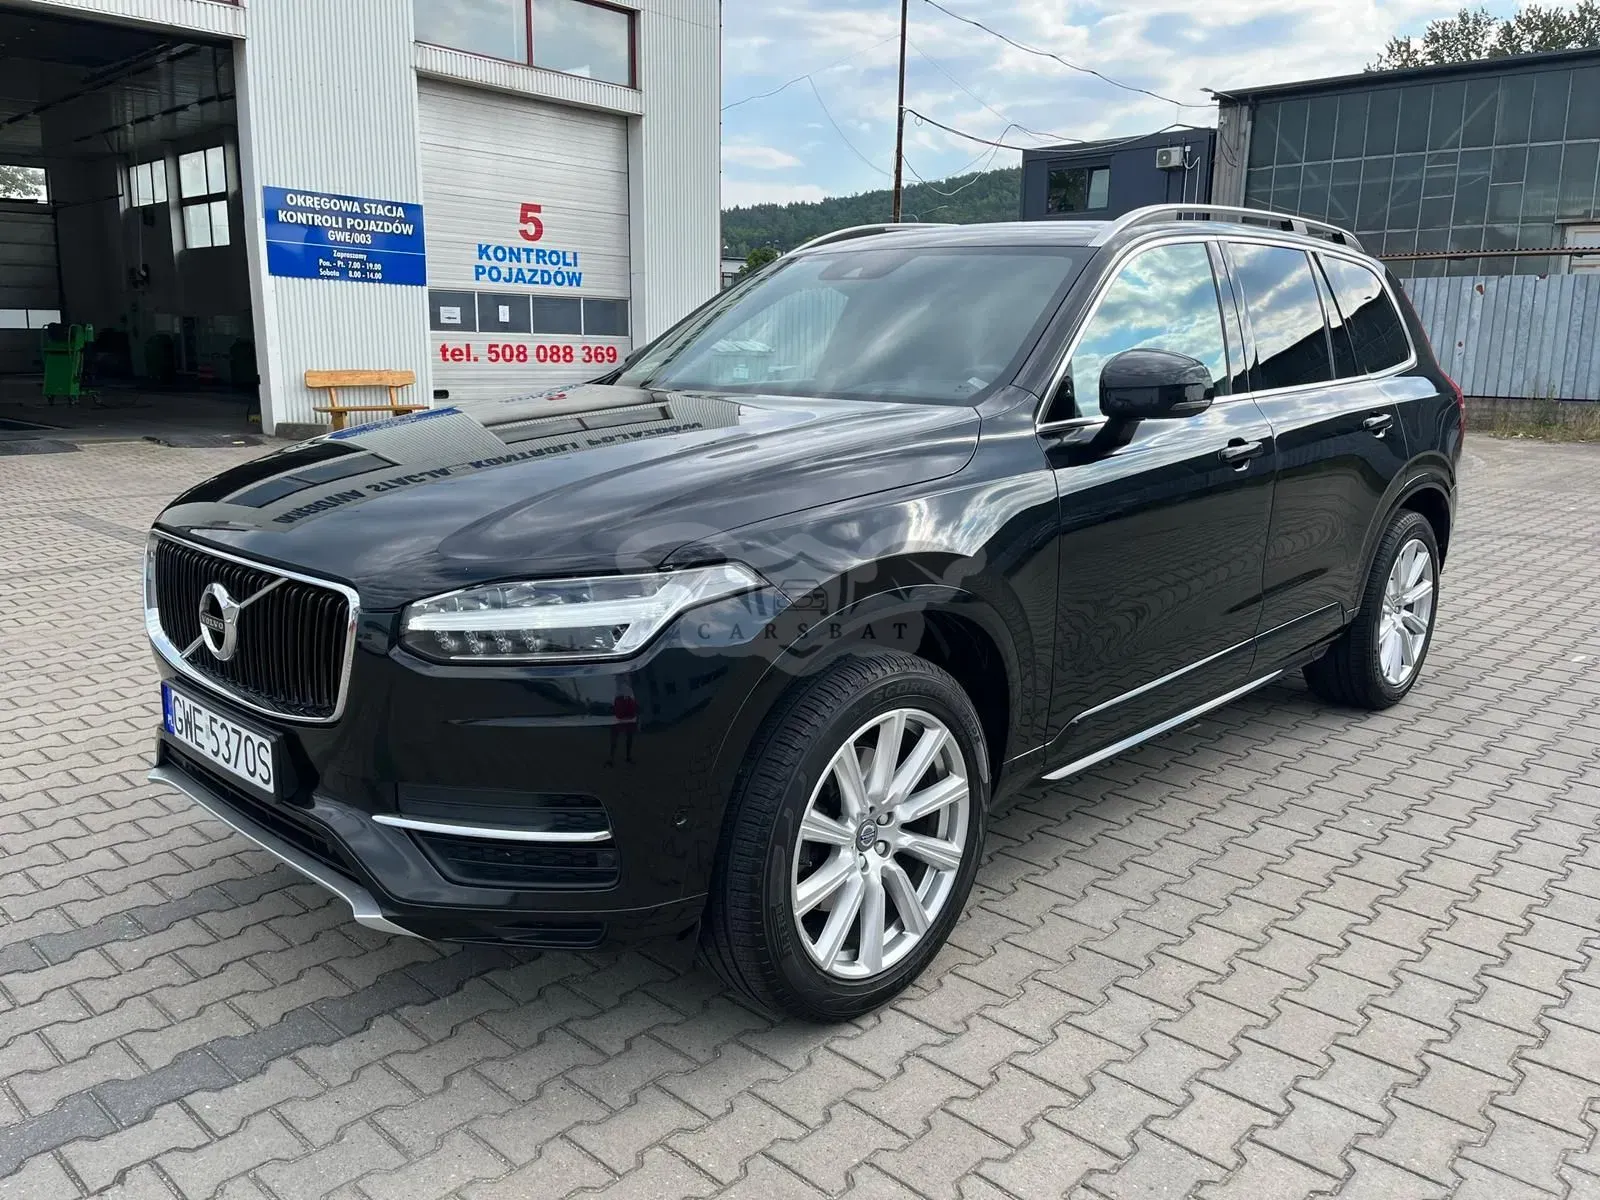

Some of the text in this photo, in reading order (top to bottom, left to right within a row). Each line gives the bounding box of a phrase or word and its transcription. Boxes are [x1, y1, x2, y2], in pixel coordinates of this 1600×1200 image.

[286, 193, 405, 218] OKRĘGOWA STACJA
[278, 209, 414, 236] KONTROLI POJAZDÓW
[518, 202, 544, 241] 5
[328, 230, 372, 245] GWE/003
[333, 250, 368, 261] Zapraszamy
[477, 243, 578, 267] KONTROLI
[319, 258, 332, 267] Pon.
[337, 260, 346, 268] Pt.
[348, 261, 361, 269] 7.00
[366, 262, 382, 271] 19.00
[319, 268, 340, 277] Sobota
[348, 270, 361, 278] 8.00
[366, 271, 382, 280] 14.00
[474, 264, 583, 287] POJAZDÓW
[440, 343, 618, 363] tel. 508 088 369
[201, 614, 224, 630] VOLVO
[167, 713, 175, 727] PL
